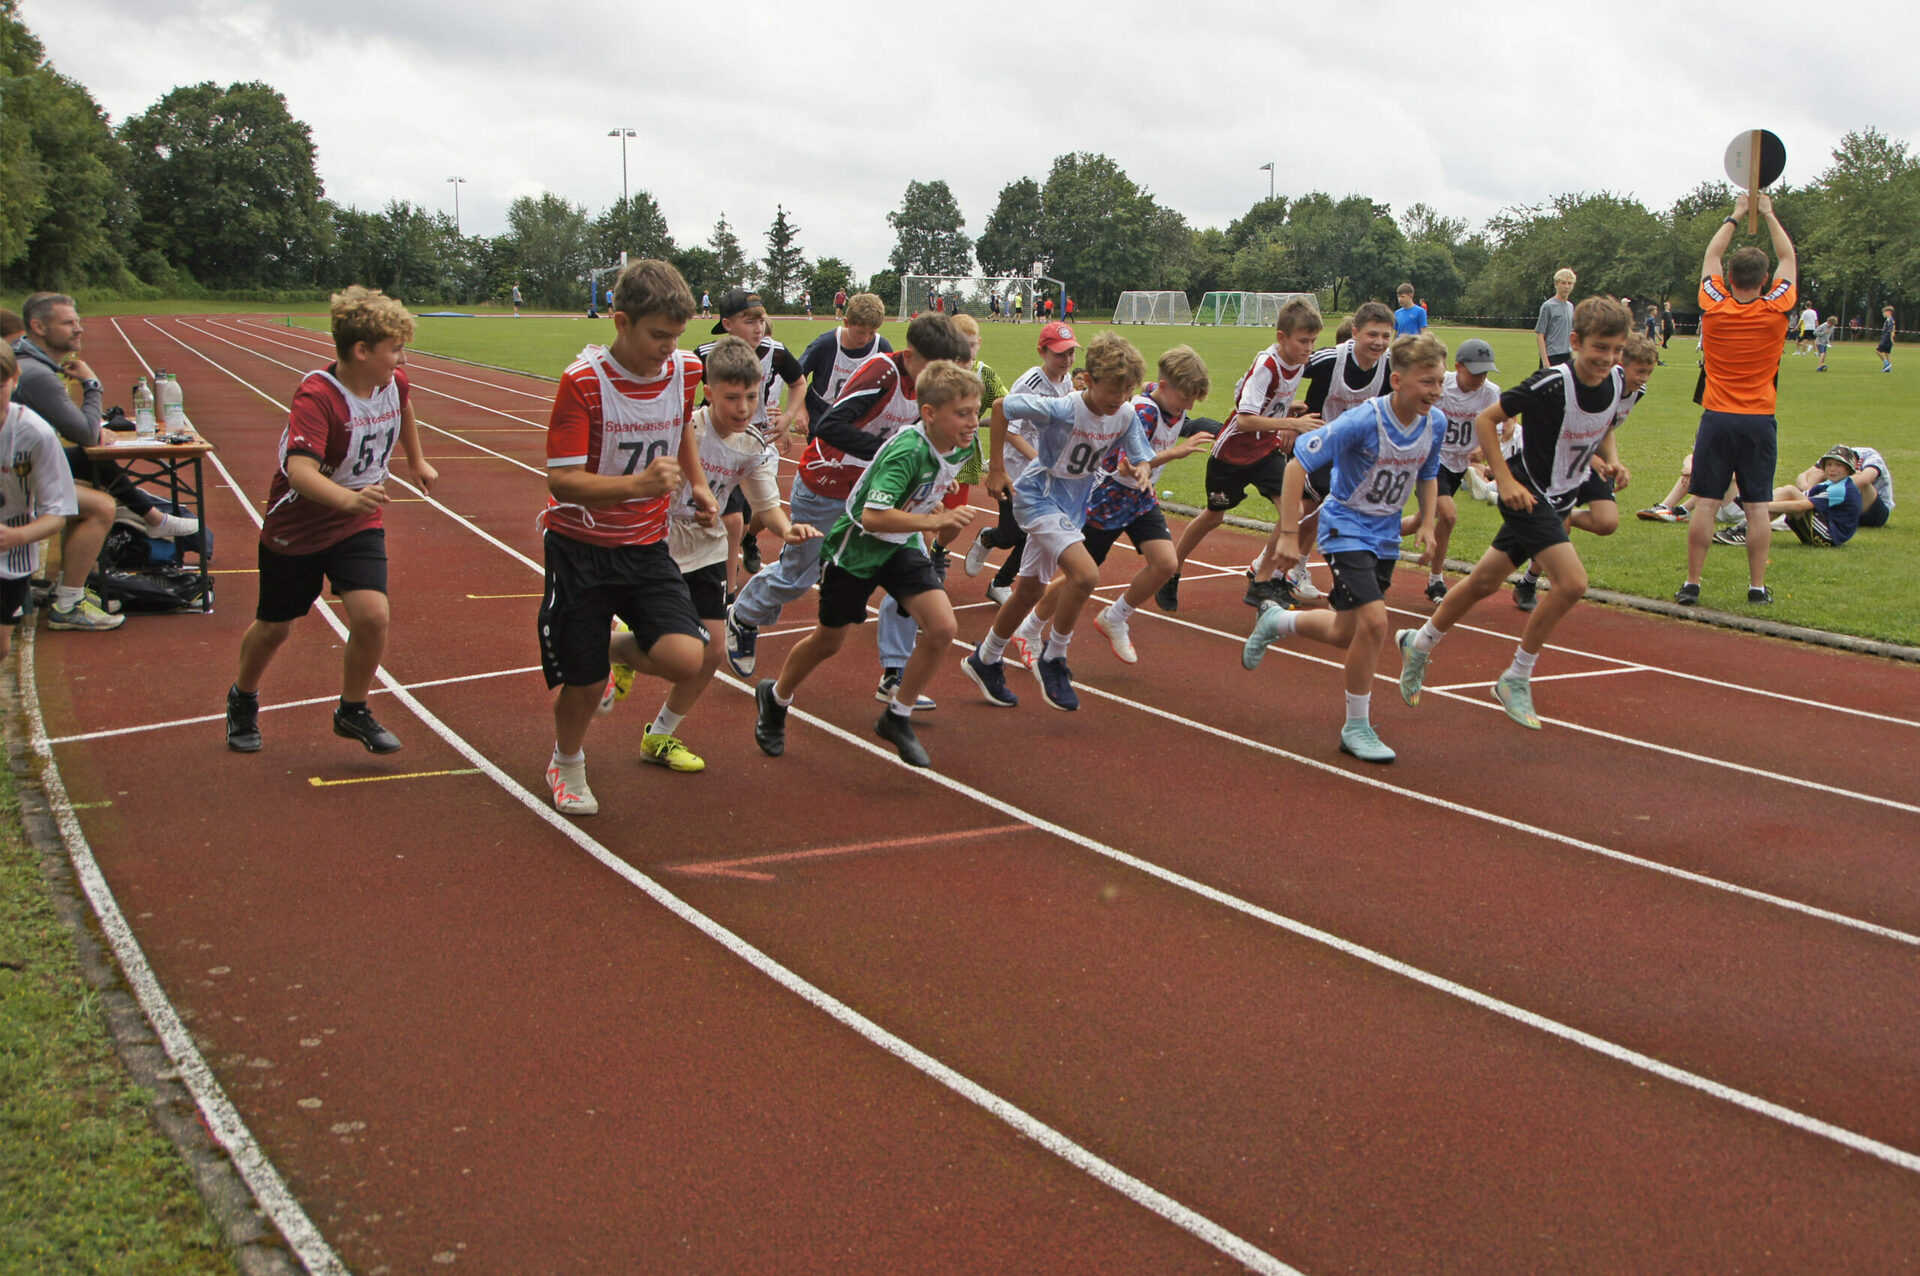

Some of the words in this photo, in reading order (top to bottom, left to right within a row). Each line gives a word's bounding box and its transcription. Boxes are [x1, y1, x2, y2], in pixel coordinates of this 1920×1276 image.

[605, 420, 672, 434] Sparkasse
[1446, 419, 1472, 447] 50
[352, 427, 396, 477] 51
[1365, 469, 1411, 506] 98
